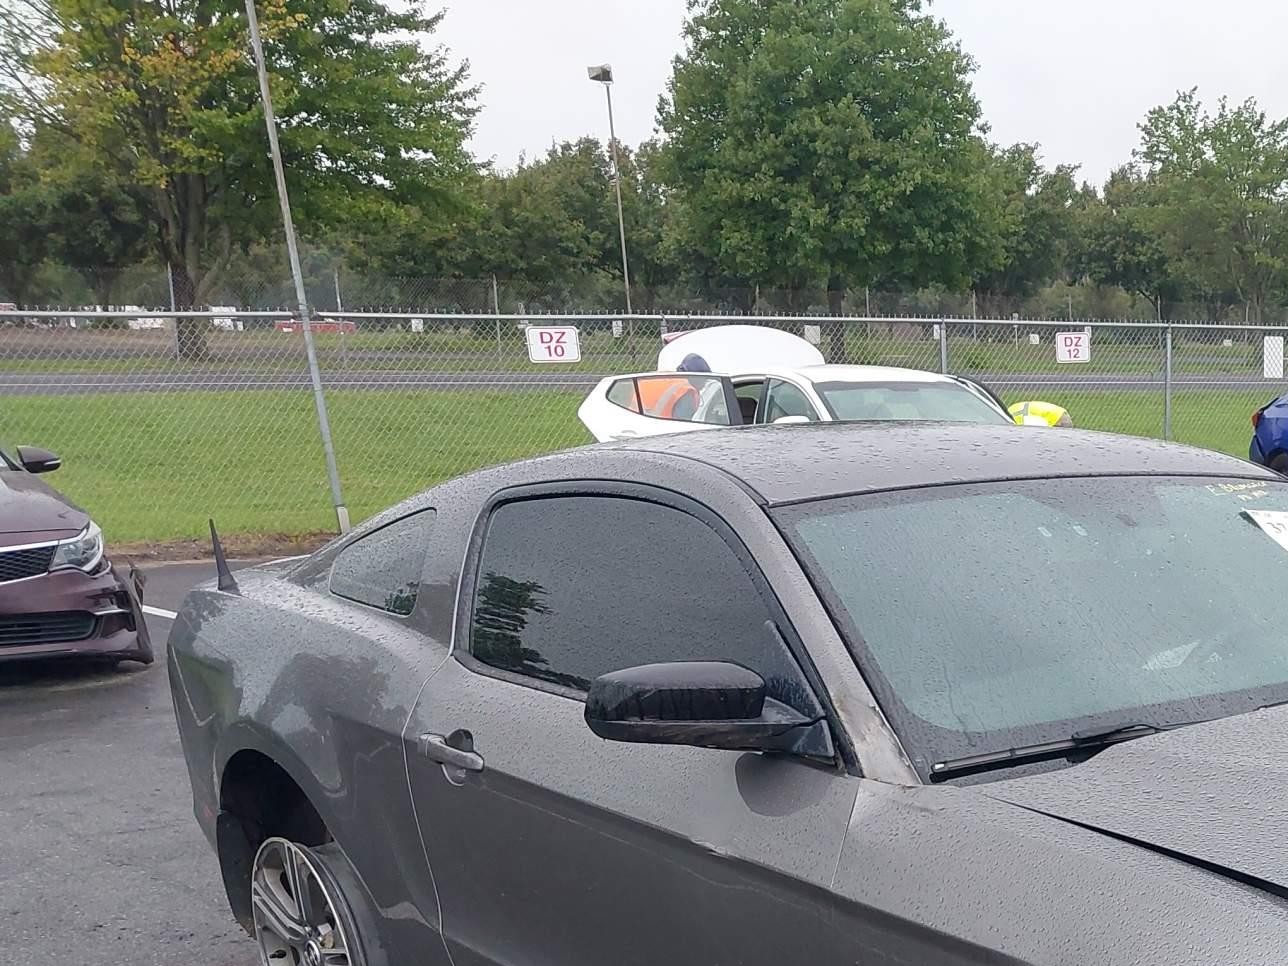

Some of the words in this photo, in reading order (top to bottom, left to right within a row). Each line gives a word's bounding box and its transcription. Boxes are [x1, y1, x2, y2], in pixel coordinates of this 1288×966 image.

[540, 331, 567, 344] DZ
[1064, 336, 1082, 347] DZ
[544, 344, 565, 358] 10
[1067, 348, 1080, 359] 12
